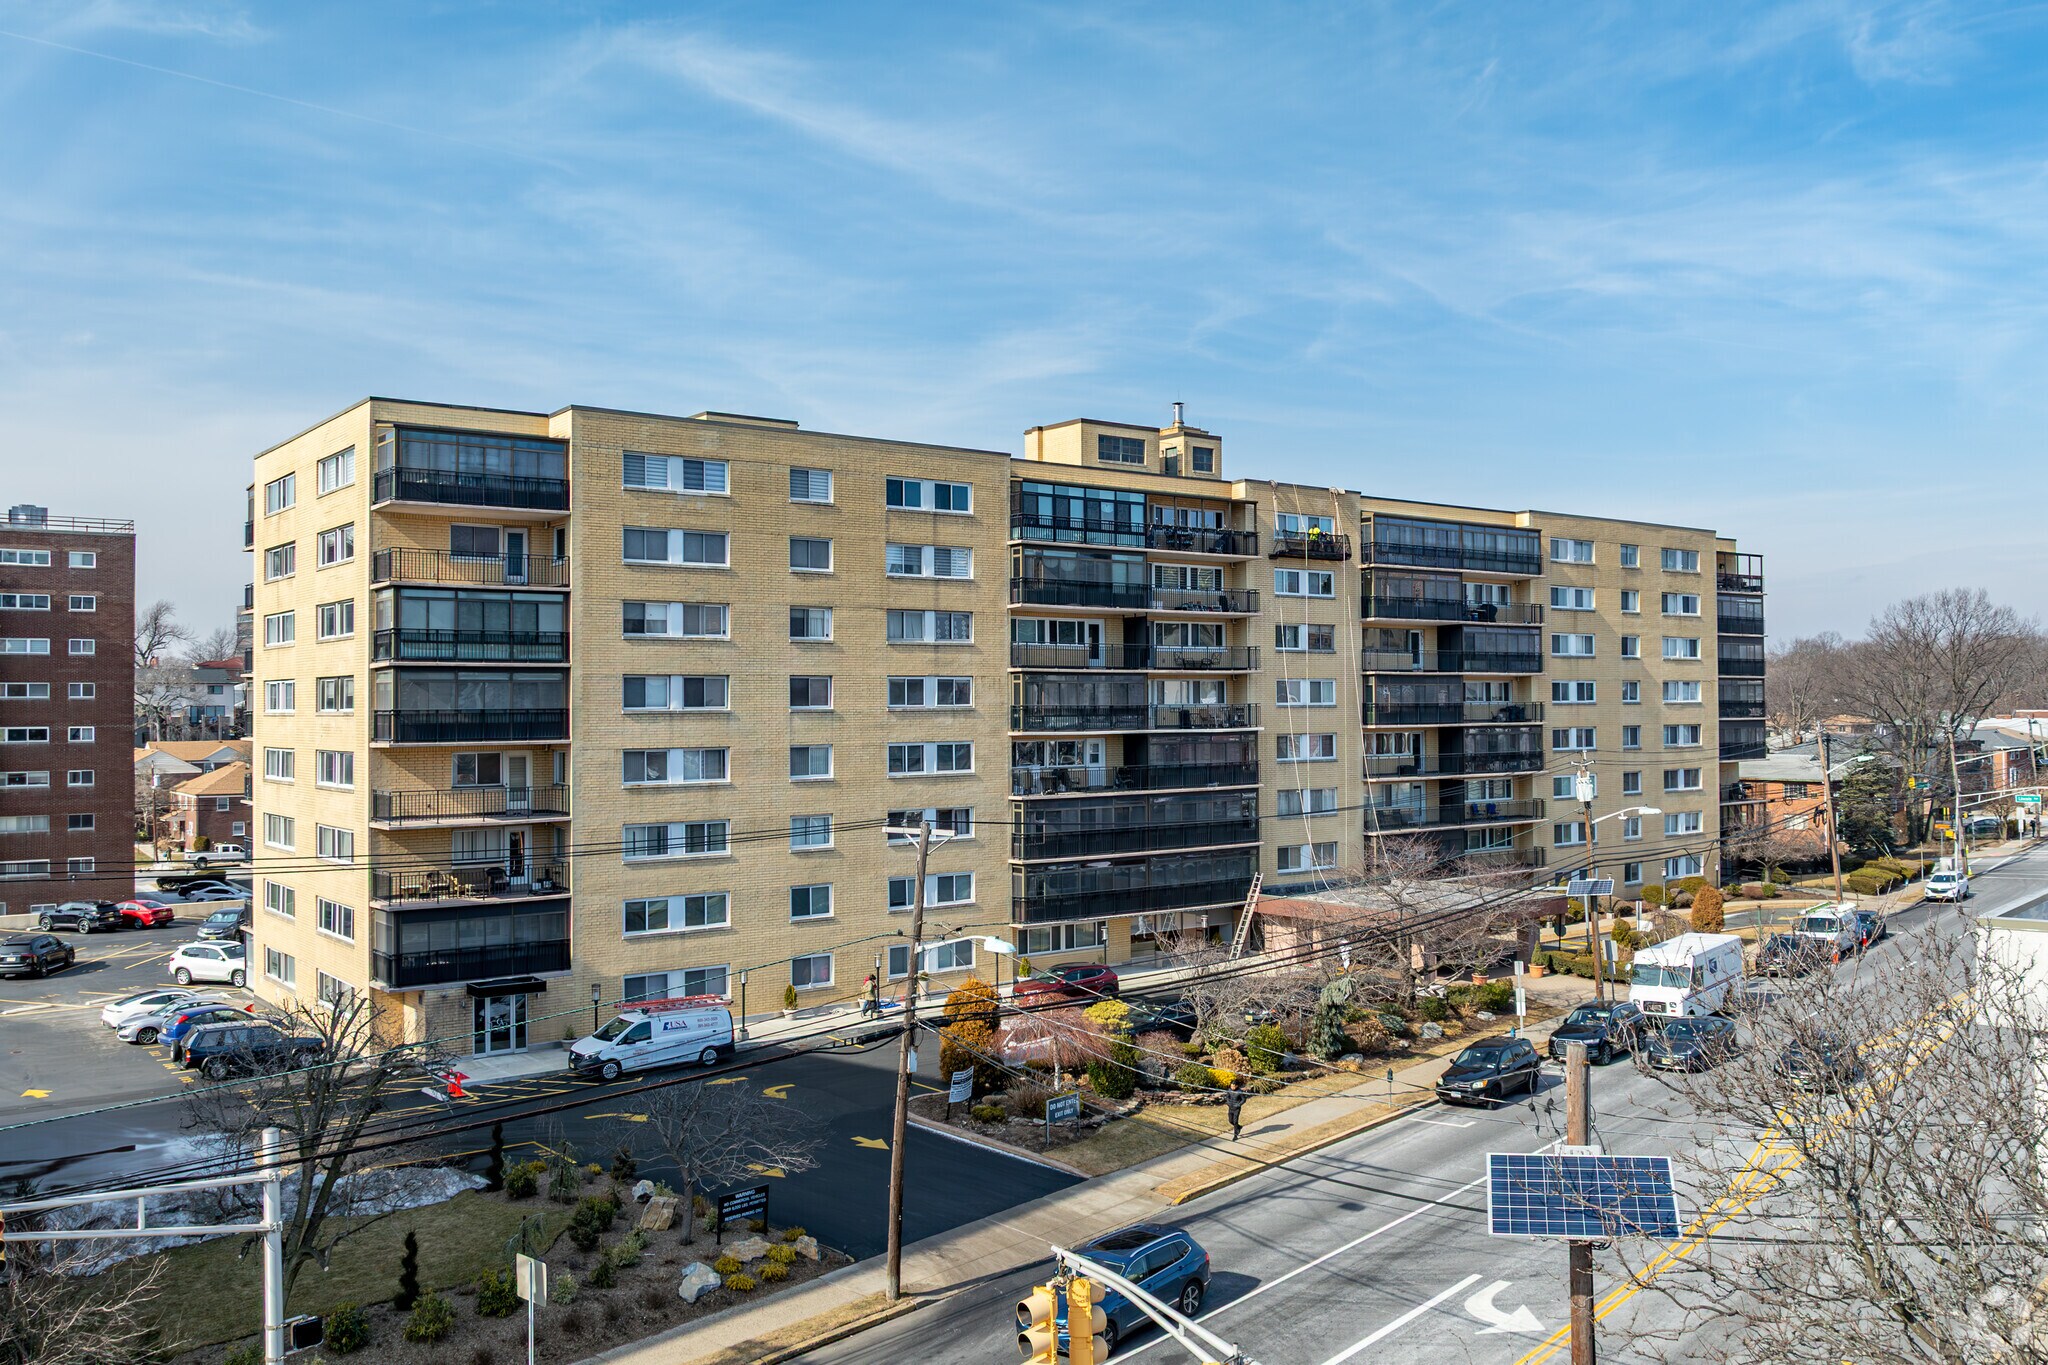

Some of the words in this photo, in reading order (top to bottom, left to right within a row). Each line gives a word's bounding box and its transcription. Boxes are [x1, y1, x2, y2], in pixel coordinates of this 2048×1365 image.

[670, 1020, 687, 1028] USA
[1056, 1100, 1065, 1108] NOT
[1066, 1098, 1077, 1106] ENTE
[1054, 1110, 1063, 1118] EXIT
[1064, 1107, 1074, 1115] ONLY
[735, 1190, 755, 1198] WARNING
